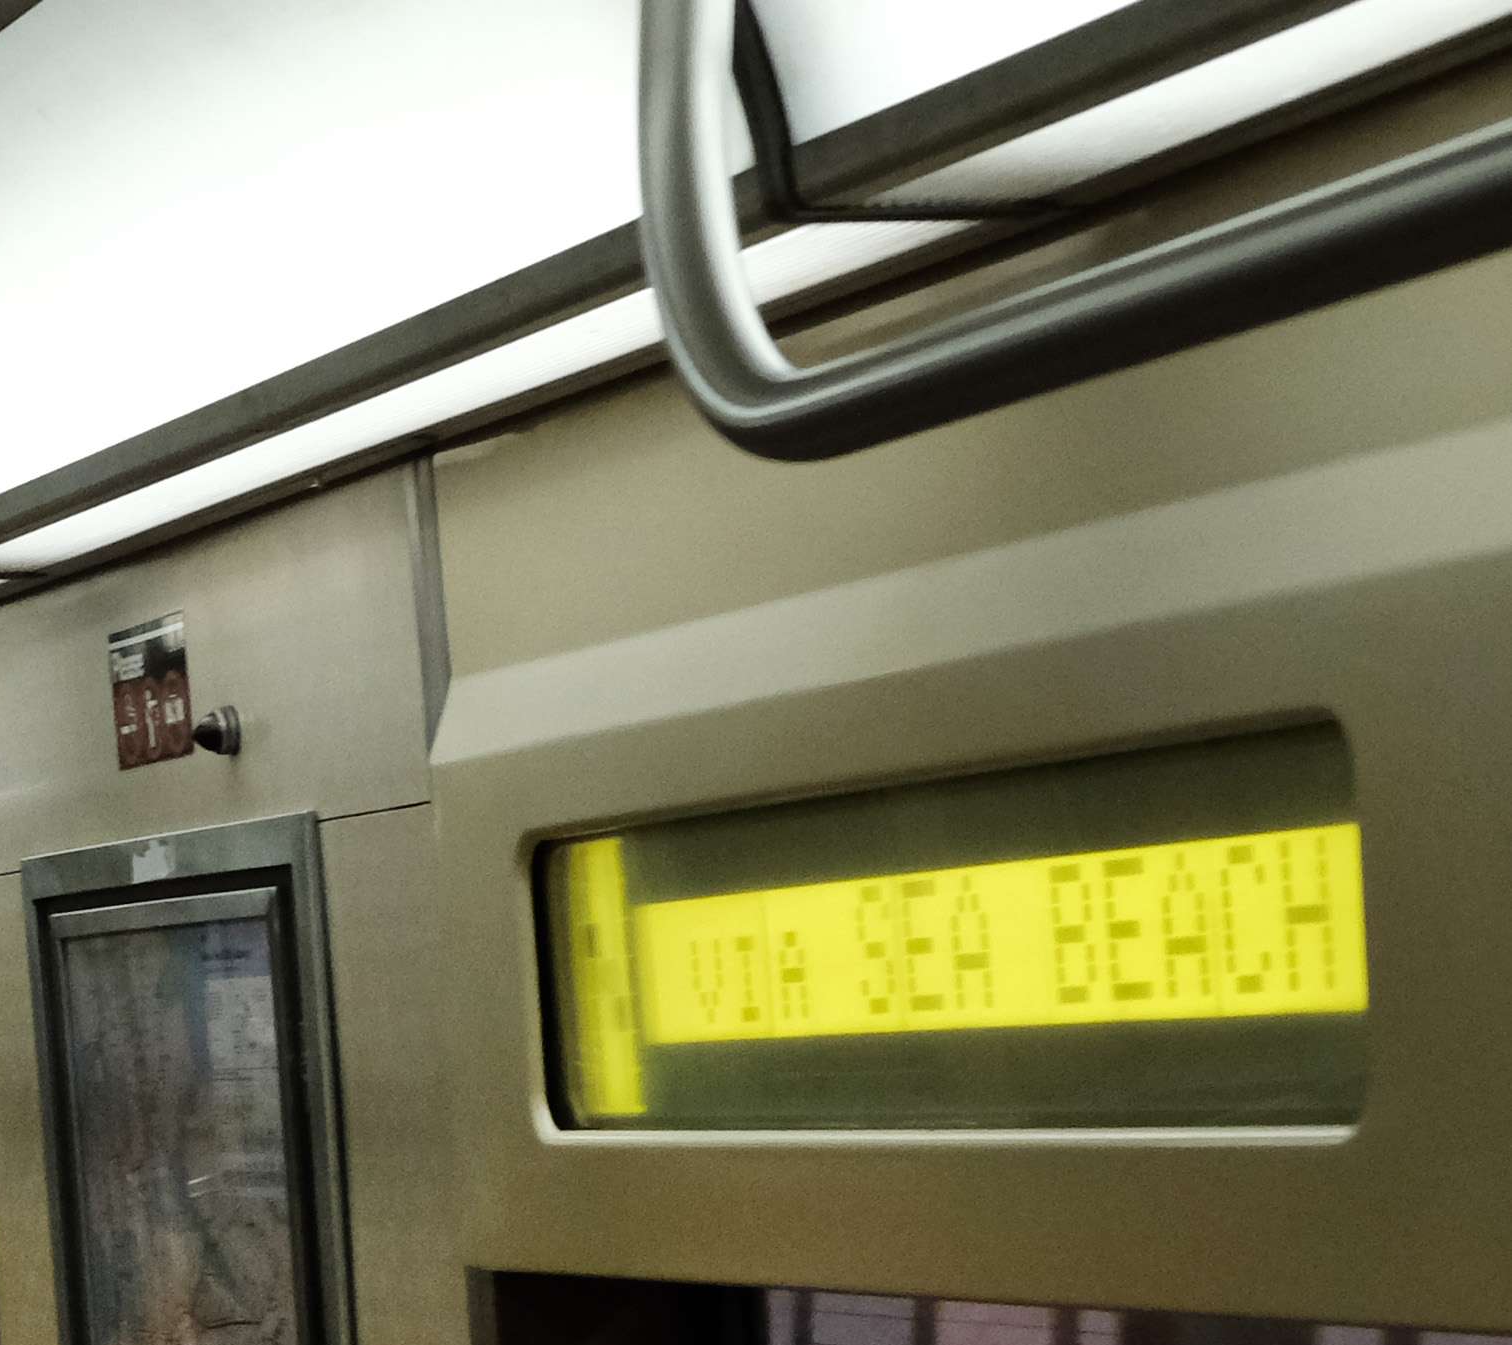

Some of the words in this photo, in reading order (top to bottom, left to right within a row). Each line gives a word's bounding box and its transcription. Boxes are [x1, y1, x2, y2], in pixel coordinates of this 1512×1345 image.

[689, 930, 810, 1024] VIA
[856, 875, 995, 1015] SEA
[1048, 835, 1337, 1005] BEACH
